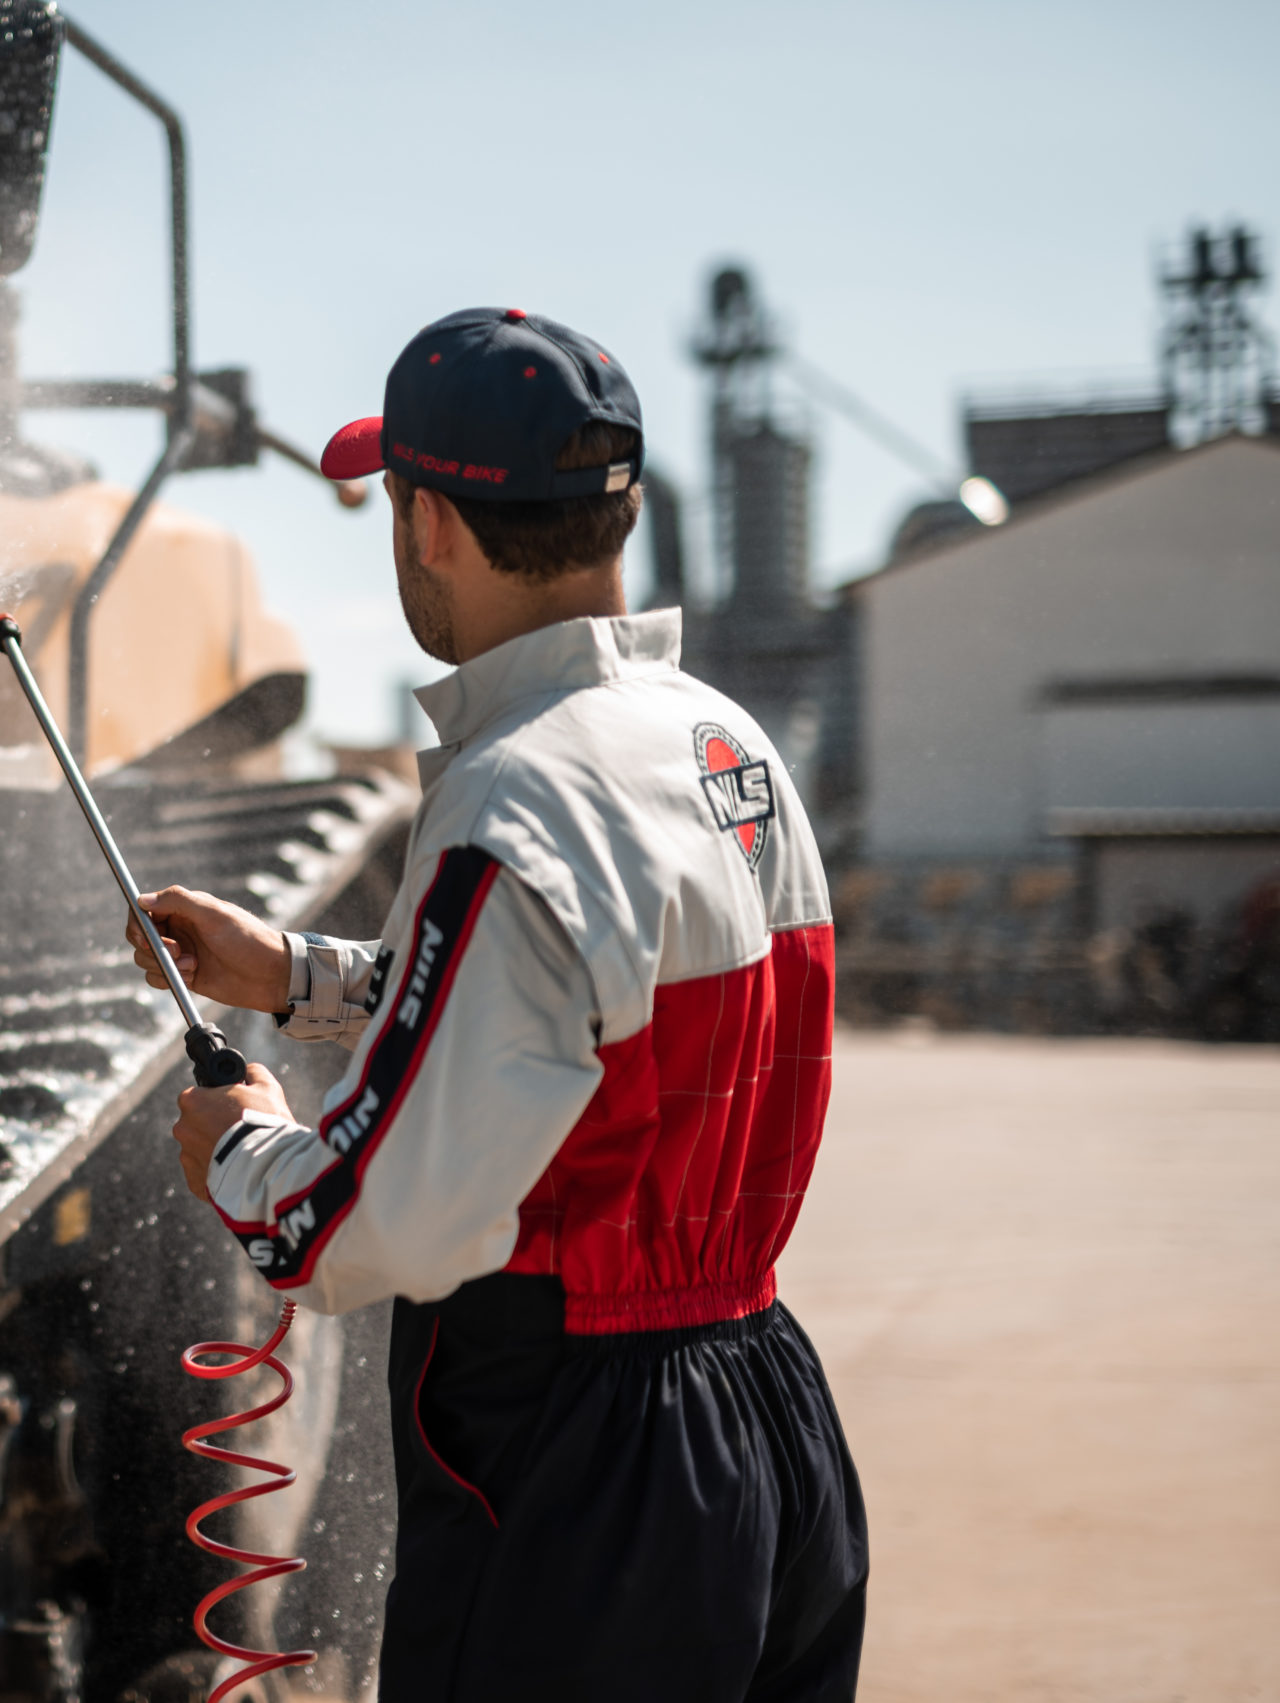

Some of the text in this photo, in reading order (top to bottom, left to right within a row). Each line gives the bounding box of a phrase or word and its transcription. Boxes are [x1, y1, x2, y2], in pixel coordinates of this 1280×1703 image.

[416, 453, 460, 475] YOUR
[461, 464, 509, 484] BIKE
[398, 916, 444, 1031] NILS
[328, 1084, 380, 1153] NIL
